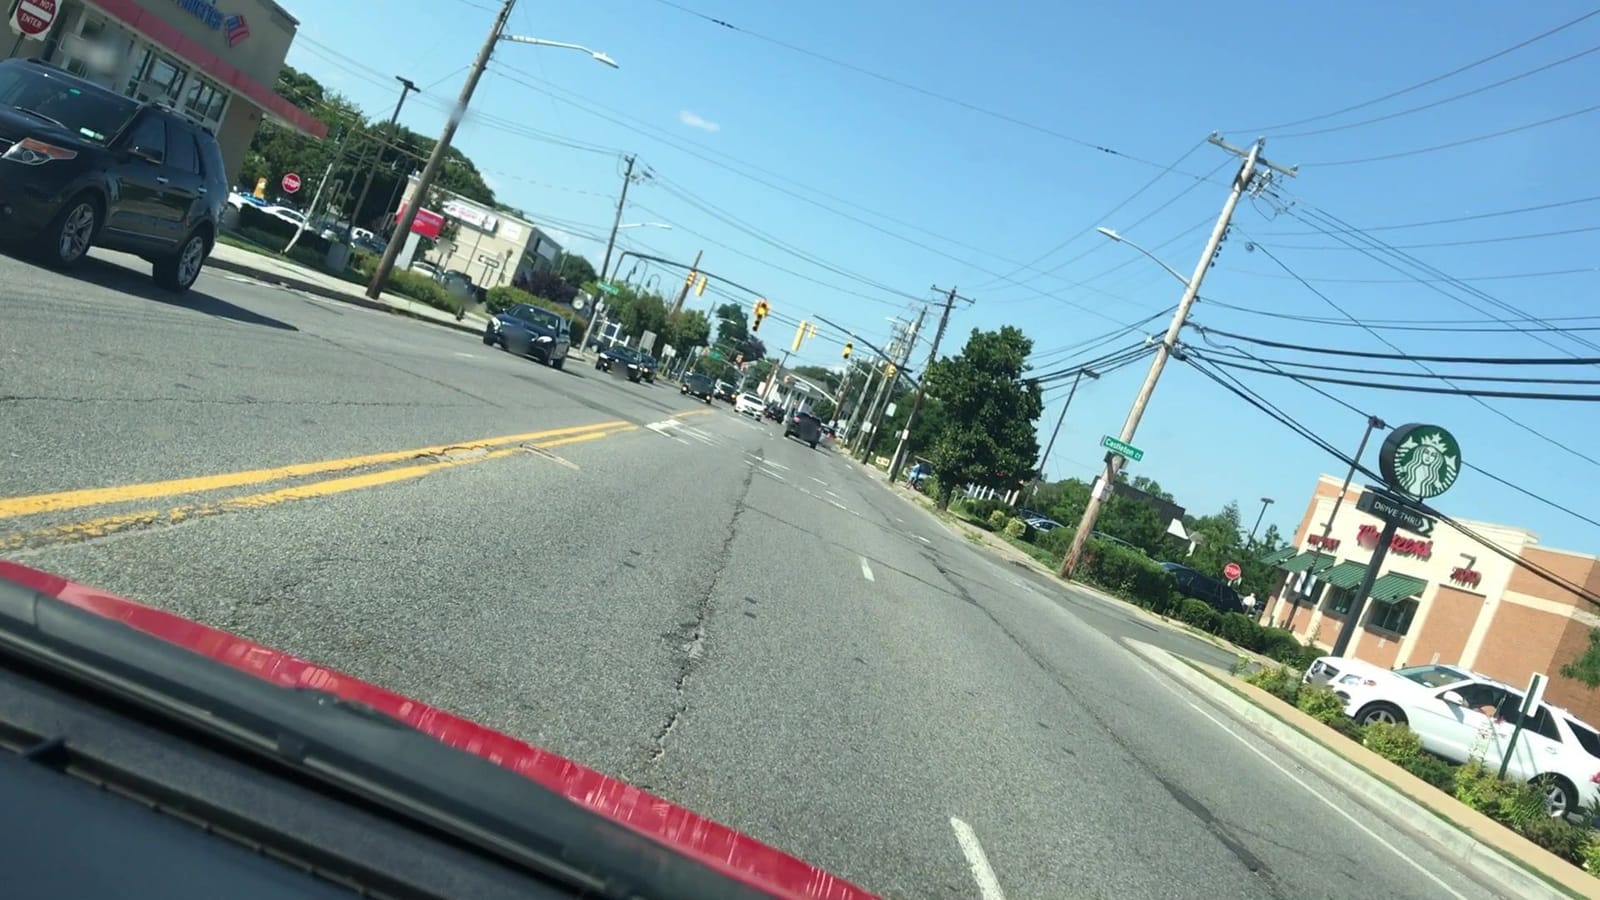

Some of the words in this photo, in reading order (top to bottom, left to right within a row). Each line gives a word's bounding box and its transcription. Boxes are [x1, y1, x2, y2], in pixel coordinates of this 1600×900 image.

[21, 13, 43, 28] ENTER
[1374, 501, 1398, 518] DRIVE
[1400, 512, 1421, 527] THRU
